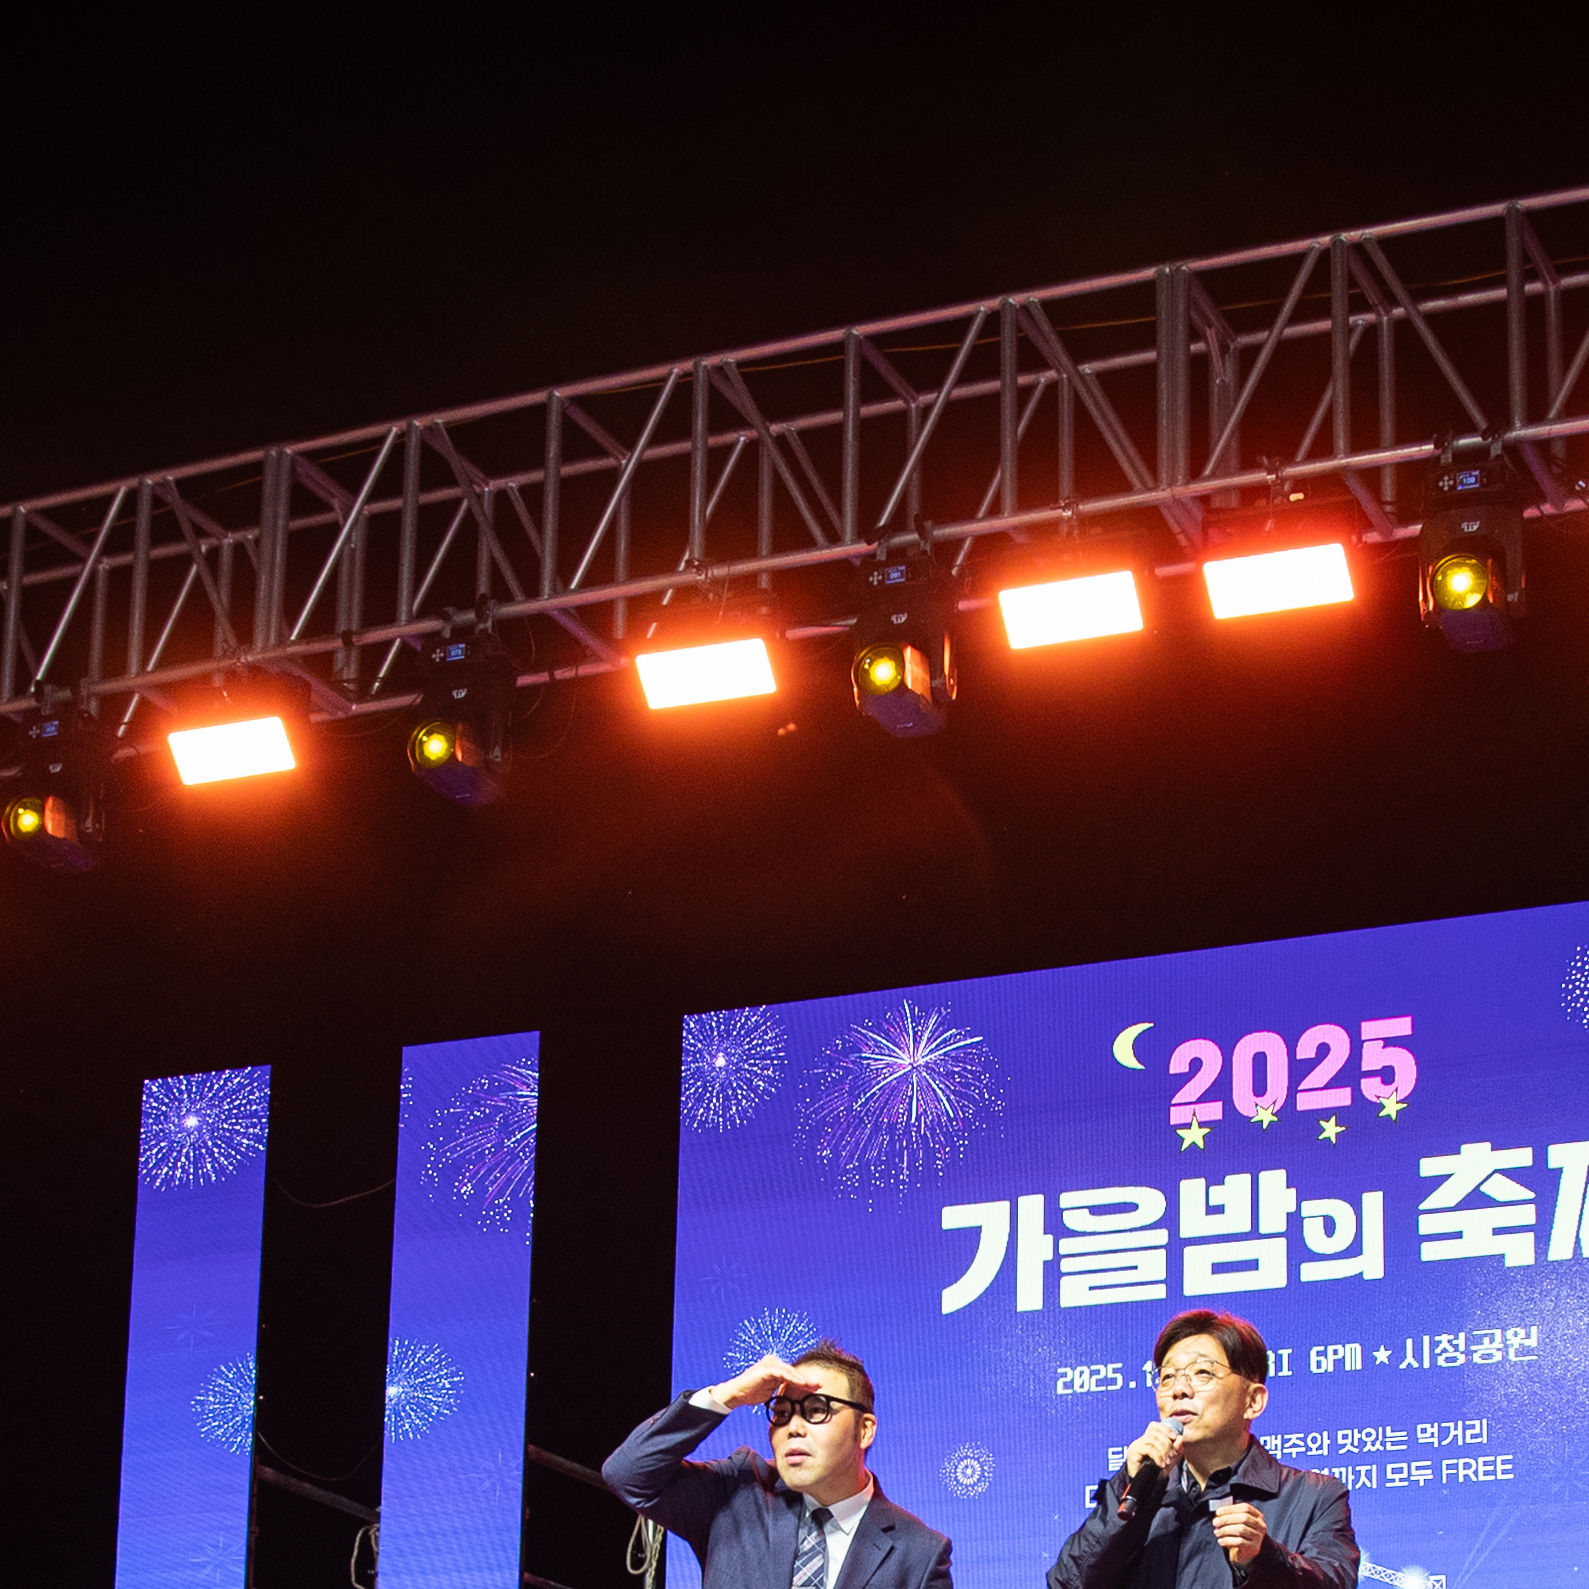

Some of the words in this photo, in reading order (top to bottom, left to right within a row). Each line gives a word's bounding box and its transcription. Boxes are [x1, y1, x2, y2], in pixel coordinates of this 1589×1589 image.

[1169, 1015, 1419, 1126] 2025
[939, 1169, 1385, 1316] 가을밤의
[1310, 1342, 1362, 1375] 6PM
[1399, 1325, 1539, 1371] 시청공원
[1259, 1430, 1331, 1460] 맥주와
[1337, 1424, 1409, 1457] 맛있는
[1416, 1417, 1489, 1447] 먹거리
[1385, 1460, 1433, 1489] 모두
[1441, 1456, 1515, 1483] FREE
